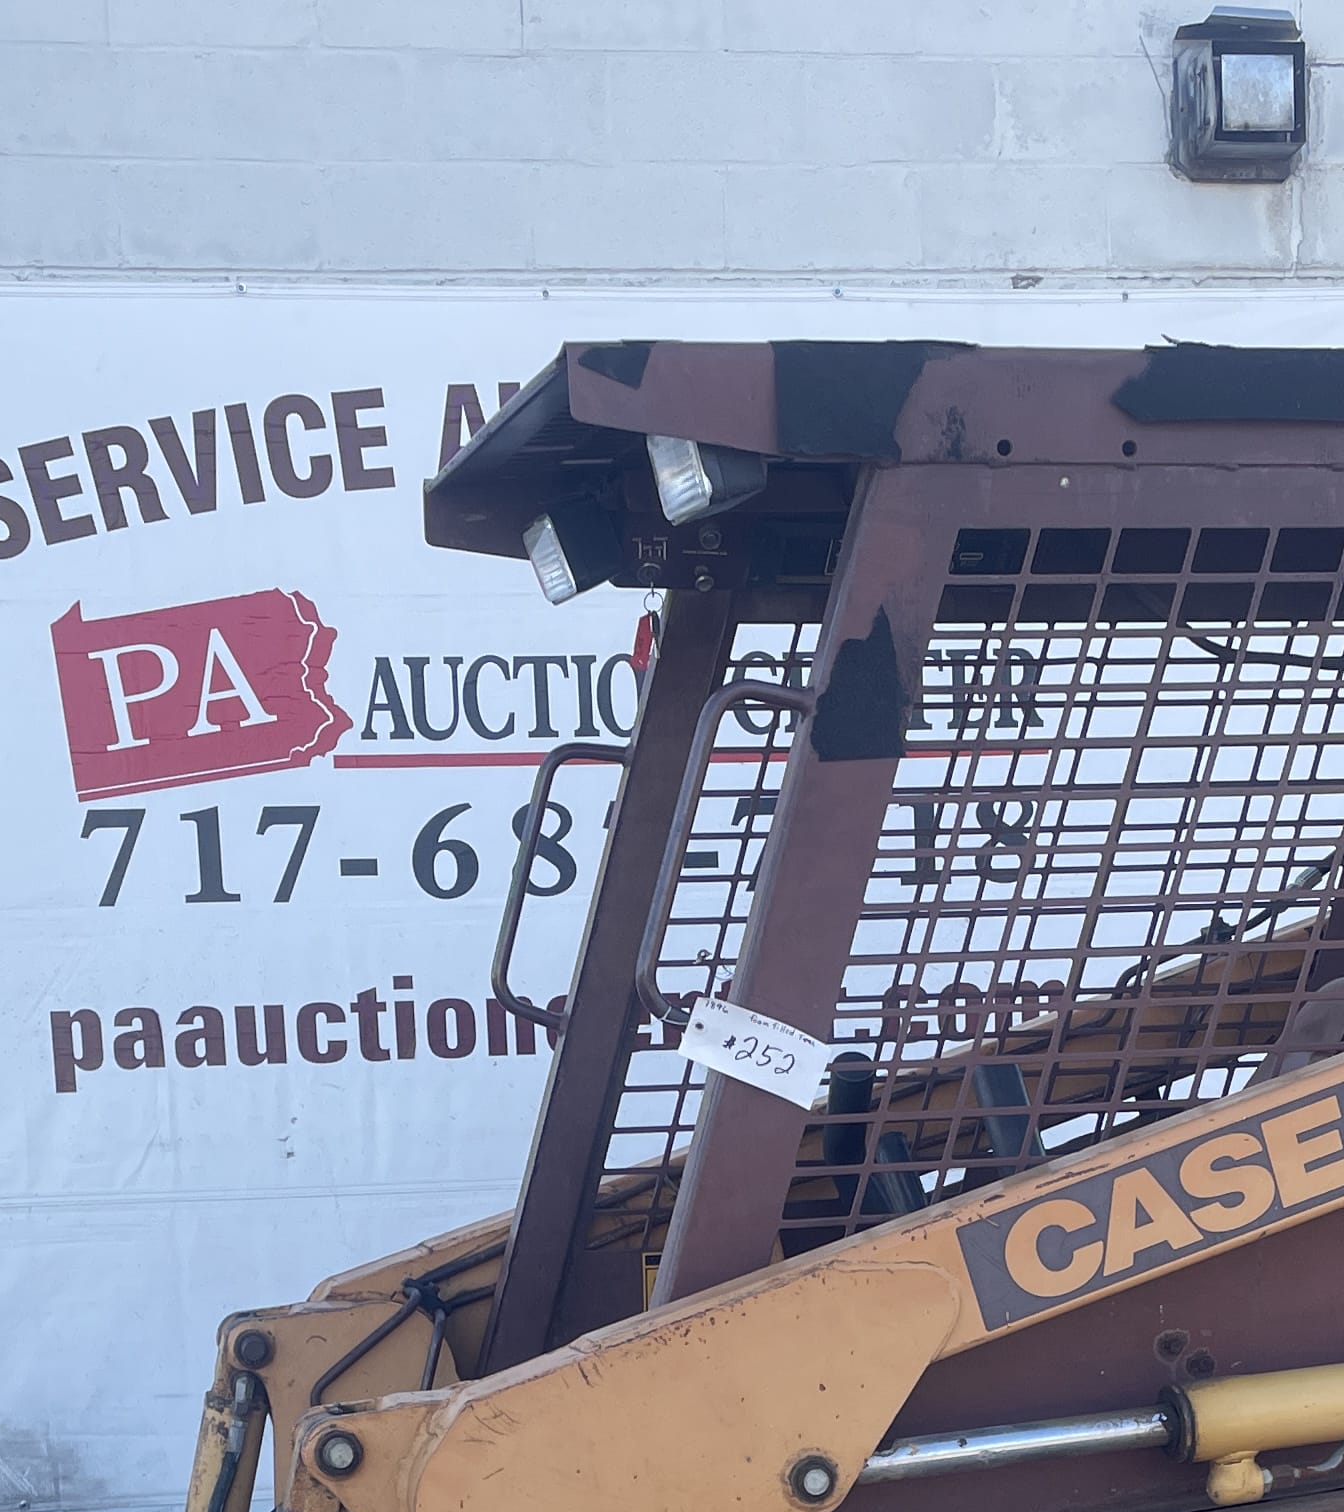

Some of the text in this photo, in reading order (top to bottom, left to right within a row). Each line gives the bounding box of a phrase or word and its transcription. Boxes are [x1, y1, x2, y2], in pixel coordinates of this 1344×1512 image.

[88, 628, 277, 752] PA
[361, 652, 649, 741] AUCTIO
[81, 797, 1036, 907] 717-68-718
[722, 1034, 795, 1075] #252
